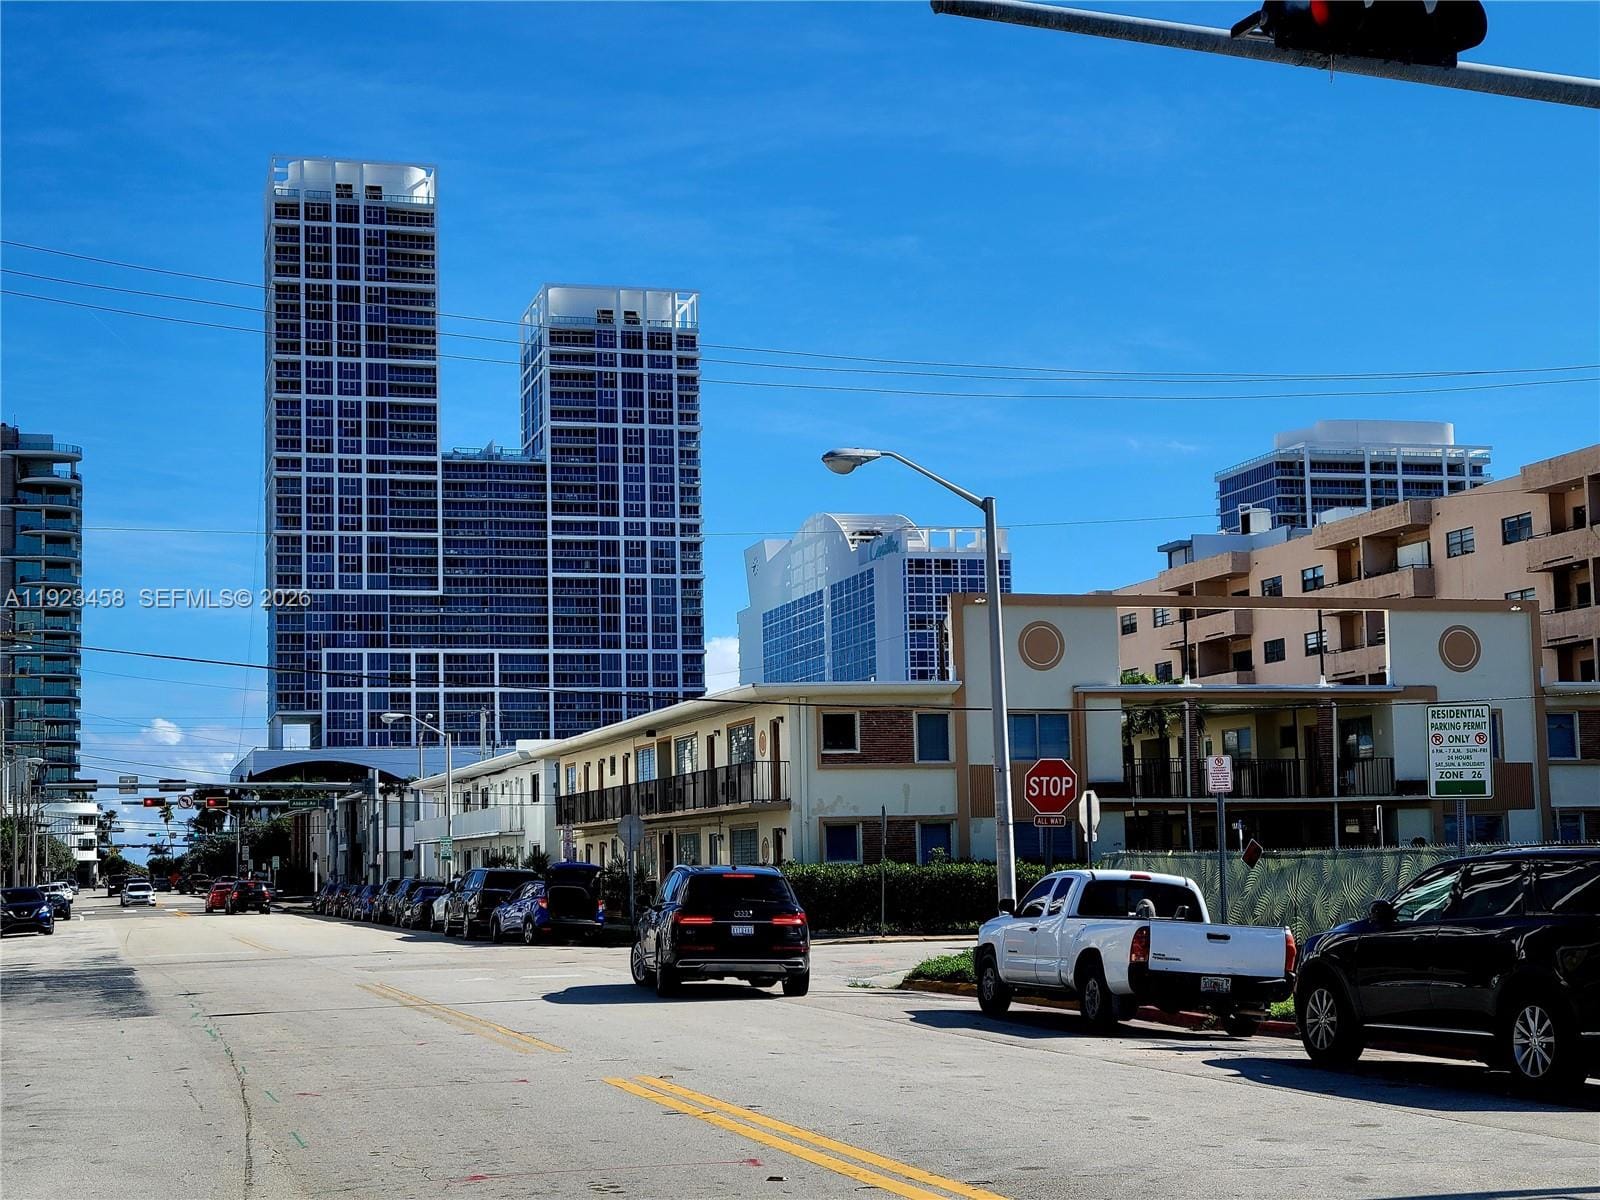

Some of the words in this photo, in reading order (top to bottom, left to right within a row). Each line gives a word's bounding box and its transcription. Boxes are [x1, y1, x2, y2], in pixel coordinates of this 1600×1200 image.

[1431, 708, 1486, 719] RESIDENTIAL
[1430, 721, 1461, 731] PARKING
[1463, 721, 1487, 730] PERMIT
[1447, 734, 1470, 744] ONLY
[1439, 771, 1464, 779] ZONE
[1471, 771, 1482, 779] 26
[1028, 776, 1073, 796] STOP
